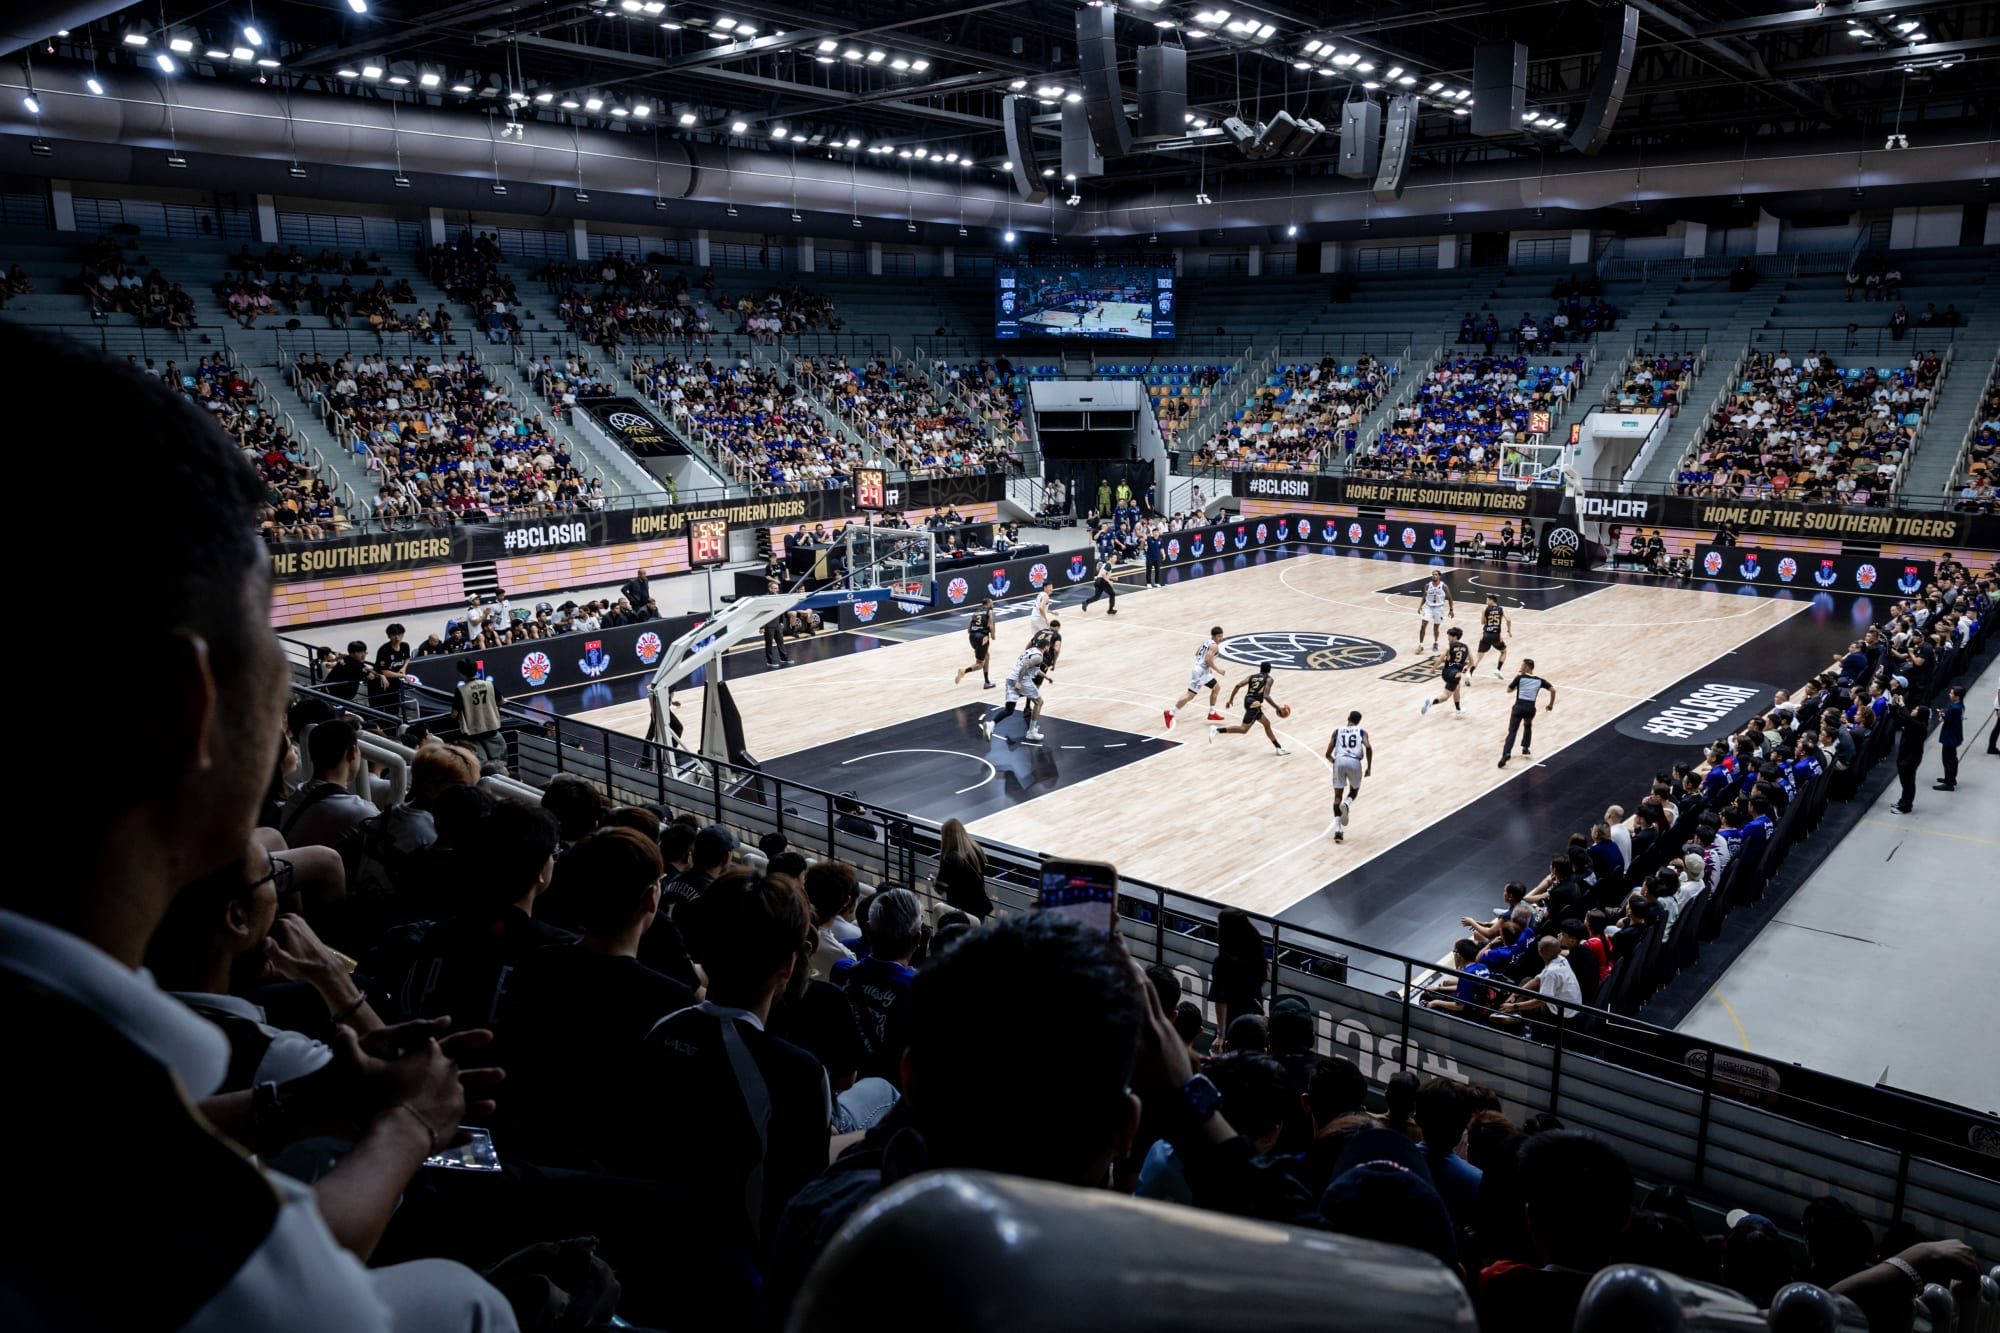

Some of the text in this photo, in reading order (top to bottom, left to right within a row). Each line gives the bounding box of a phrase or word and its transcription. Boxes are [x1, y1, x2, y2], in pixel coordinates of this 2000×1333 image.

[1531, 420, 1546, 431] 24
[861, 471, 882, 487] 5:42
[1250, 478, 1309, 496] #BCLASIA
[860, 486, 879, 505] 24
[1346, 484, 1527, 510] HOME OF THE SOUTHERN TIGERS
[632, 514, 668, 535] HOME
[669, 511, 685, 531] OF
[768, 500, 805, 519] TIGERS
[1704, 506, 1957, 538] HOME OF THE SOUTHERN TIGERS
[503, 521, 586, 549] #BCLASIA
[700, 521, 726, 539] 5:42
[300, 543, 392, 572] SOUTHERN
[394, 537, 450, 562] TIGERS
[698, 539, 721, 560] 24
[1551, 558, 1576, 567] EAST
[975, 616, 983, 626] 3
[1487, 615, 1500, 626] 25
[471, 690, 488, 706] 37
[1641, 683, 1761, 739] #BCLASIA
[1341, 734, 1357, 749] 16
